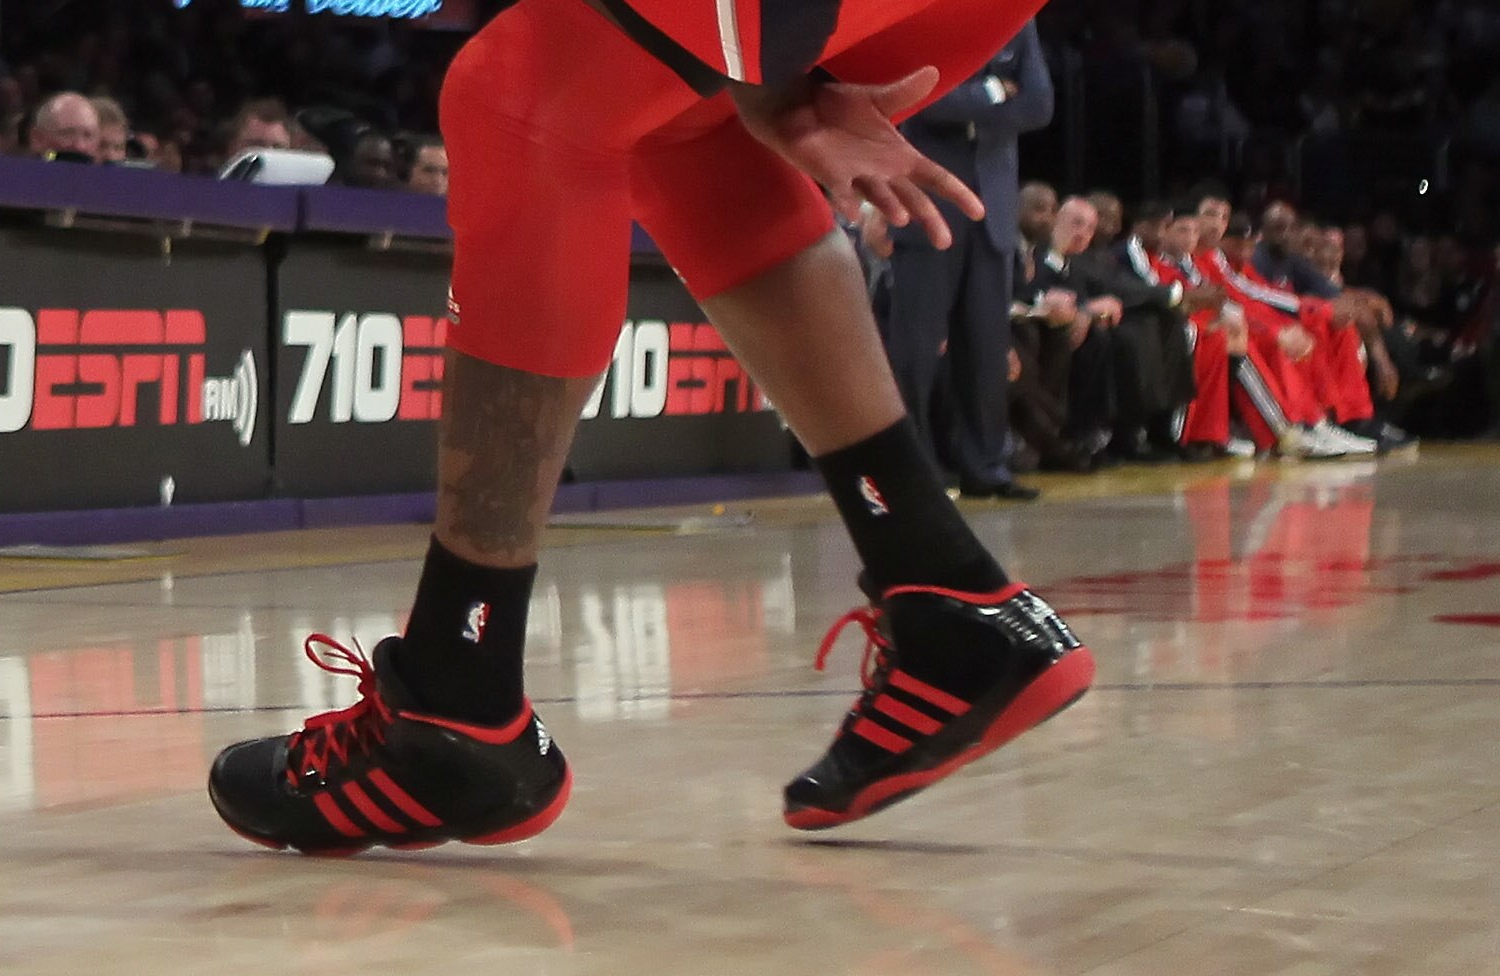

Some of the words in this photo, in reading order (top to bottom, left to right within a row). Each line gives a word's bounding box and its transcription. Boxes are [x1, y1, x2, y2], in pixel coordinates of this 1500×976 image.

[32, 309, 207, 430] ESPN
[282, 309, 403, 424] 710
[579, 319, 670, 420] 10
